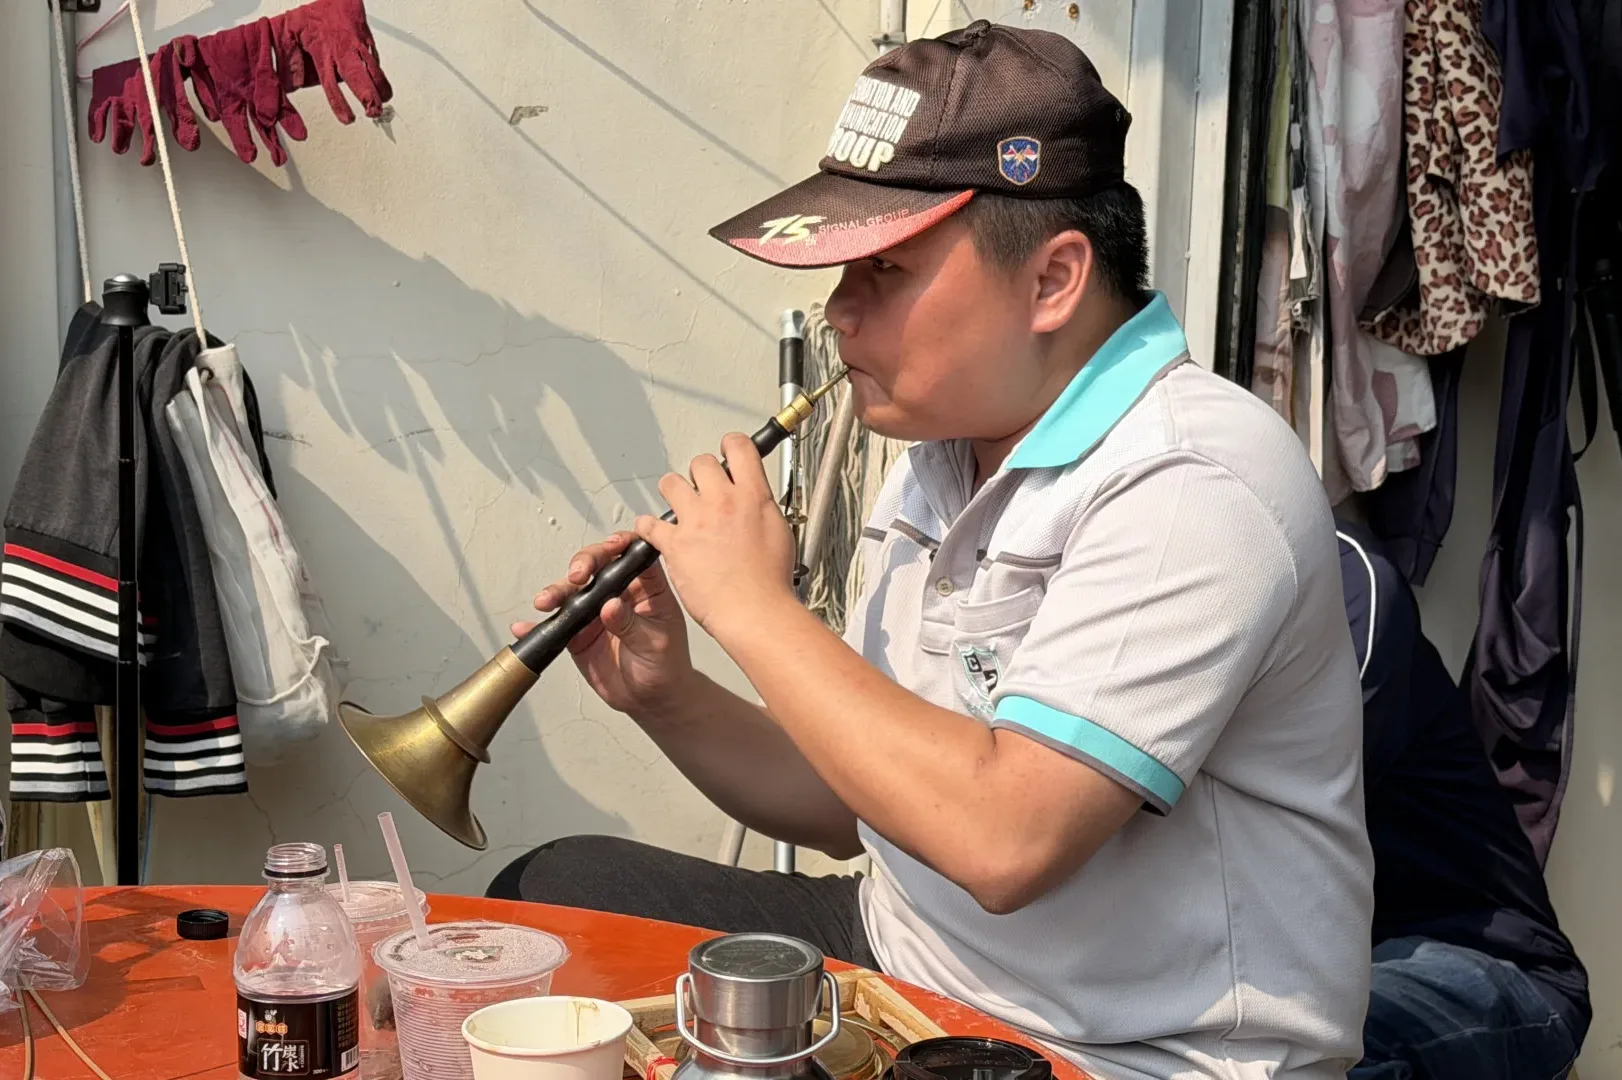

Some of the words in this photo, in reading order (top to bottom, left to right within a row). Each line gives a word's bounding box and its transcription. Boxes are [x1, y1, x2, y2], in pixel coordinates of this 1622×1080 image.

[889, 86, 921, 117] AND
[818, 219, 864, 234] SIGNAL
[866, 208, 909, 227] GROUP
